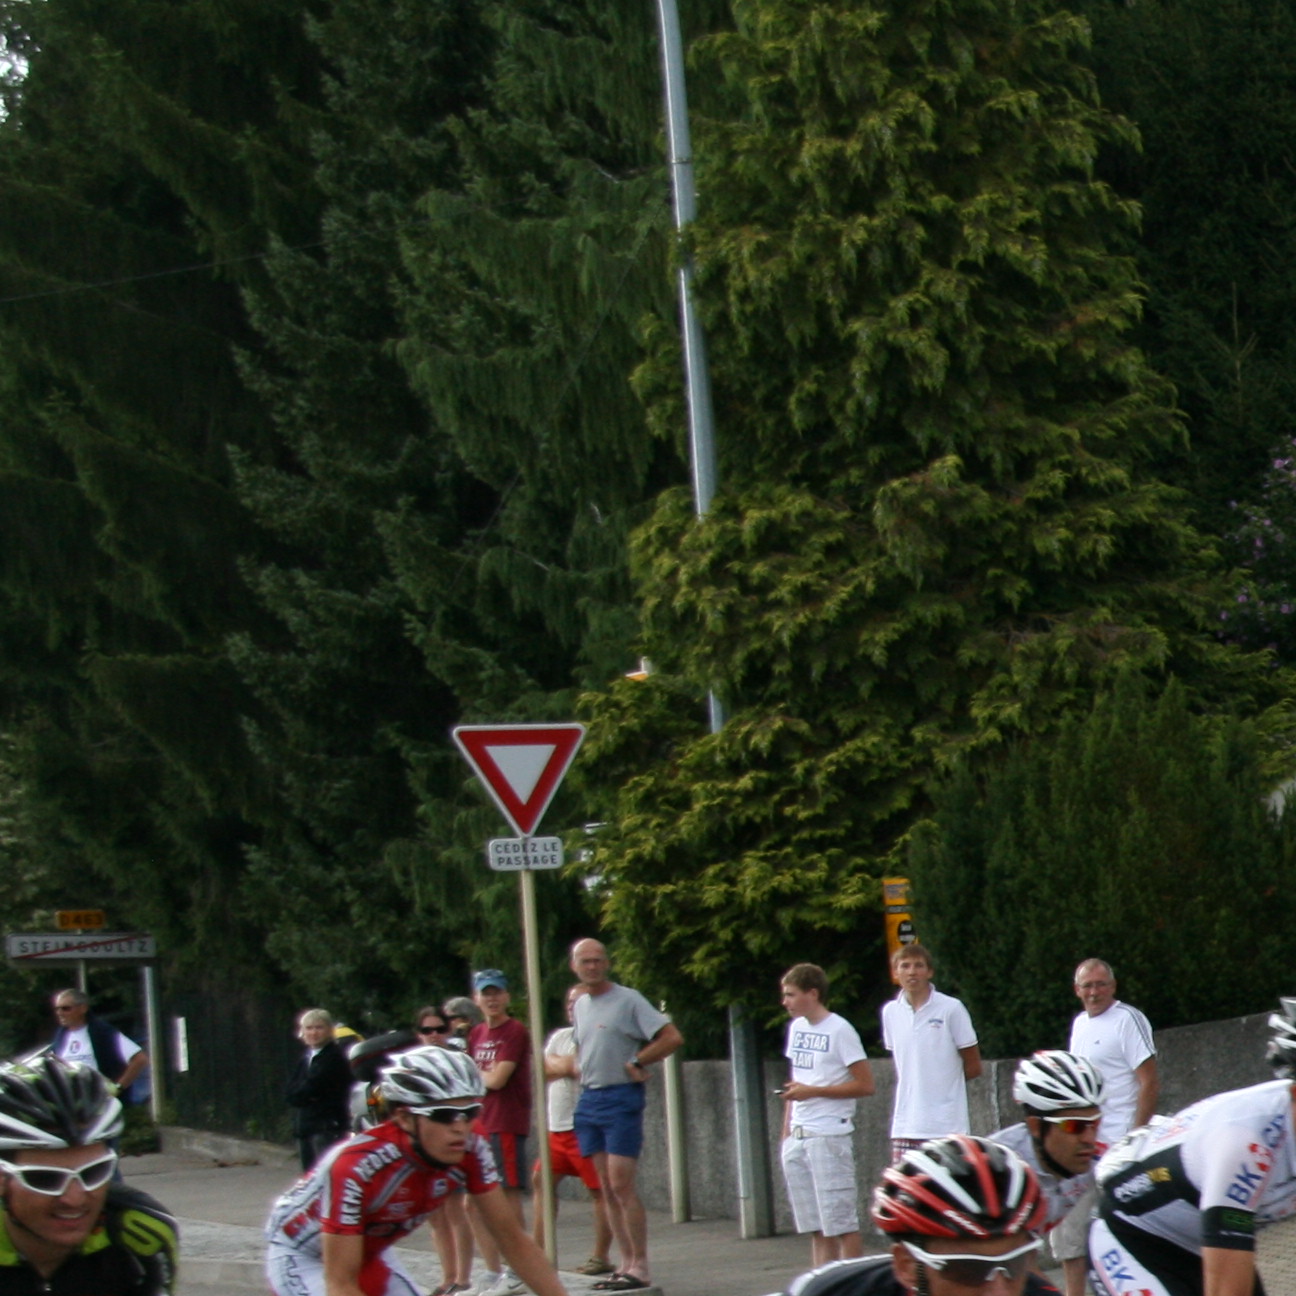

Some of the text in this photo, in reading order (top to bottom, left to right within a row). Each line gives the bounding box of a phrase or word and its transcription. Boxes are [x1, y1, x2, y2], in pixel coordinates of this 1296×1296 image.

[495, 842, 559, 854] CÉDEZ LE
[498, 855, 558, 866] PASSAGE
[794, 1032, 828, 1050] G-STAR
[1225, 1162, 1264, 1206] BK
[1101, 1249, 1136, 1293] BK
